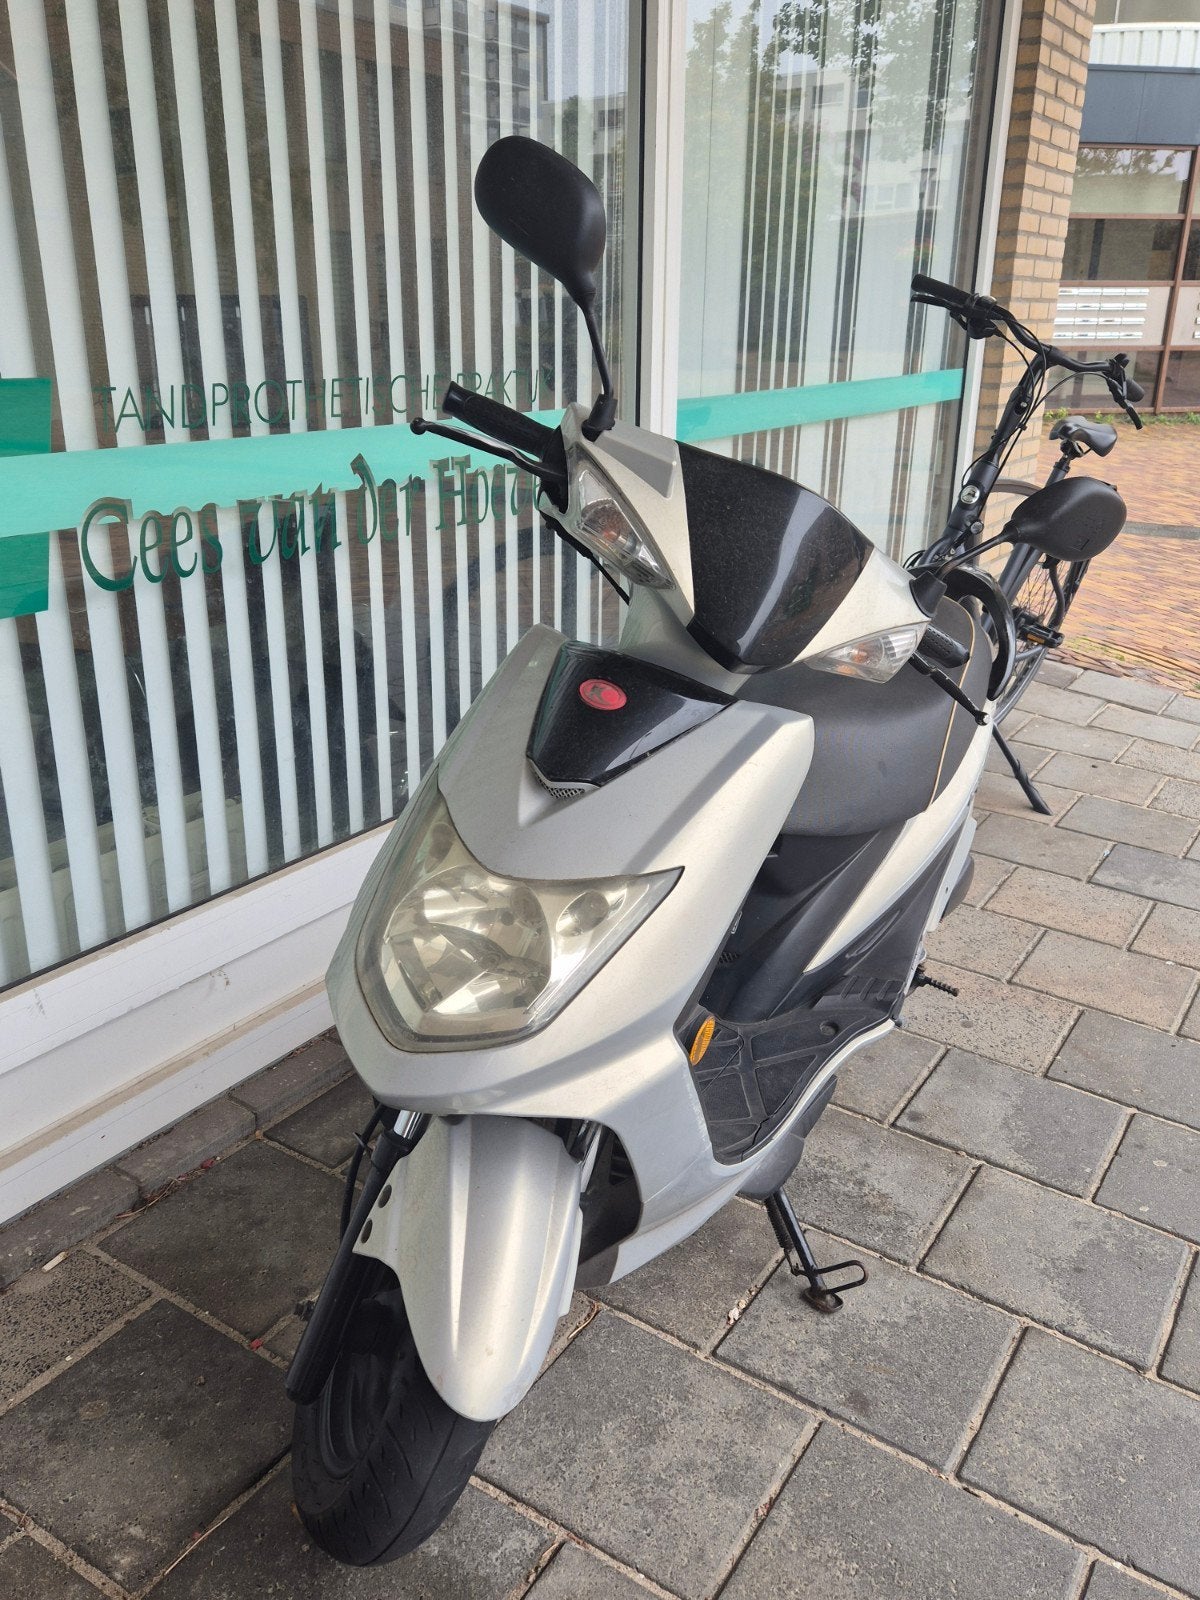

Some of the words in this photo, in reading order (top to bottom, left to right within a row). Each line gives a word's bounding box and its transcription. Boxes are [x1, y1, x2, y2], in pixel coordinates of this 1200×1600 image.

[92, 373, 446, 434] TANDPROTHETISCHE
[81, 498, 223, 592] Cees
[238, 484, 342, 565] van
[350, 454, 425, 546] der
